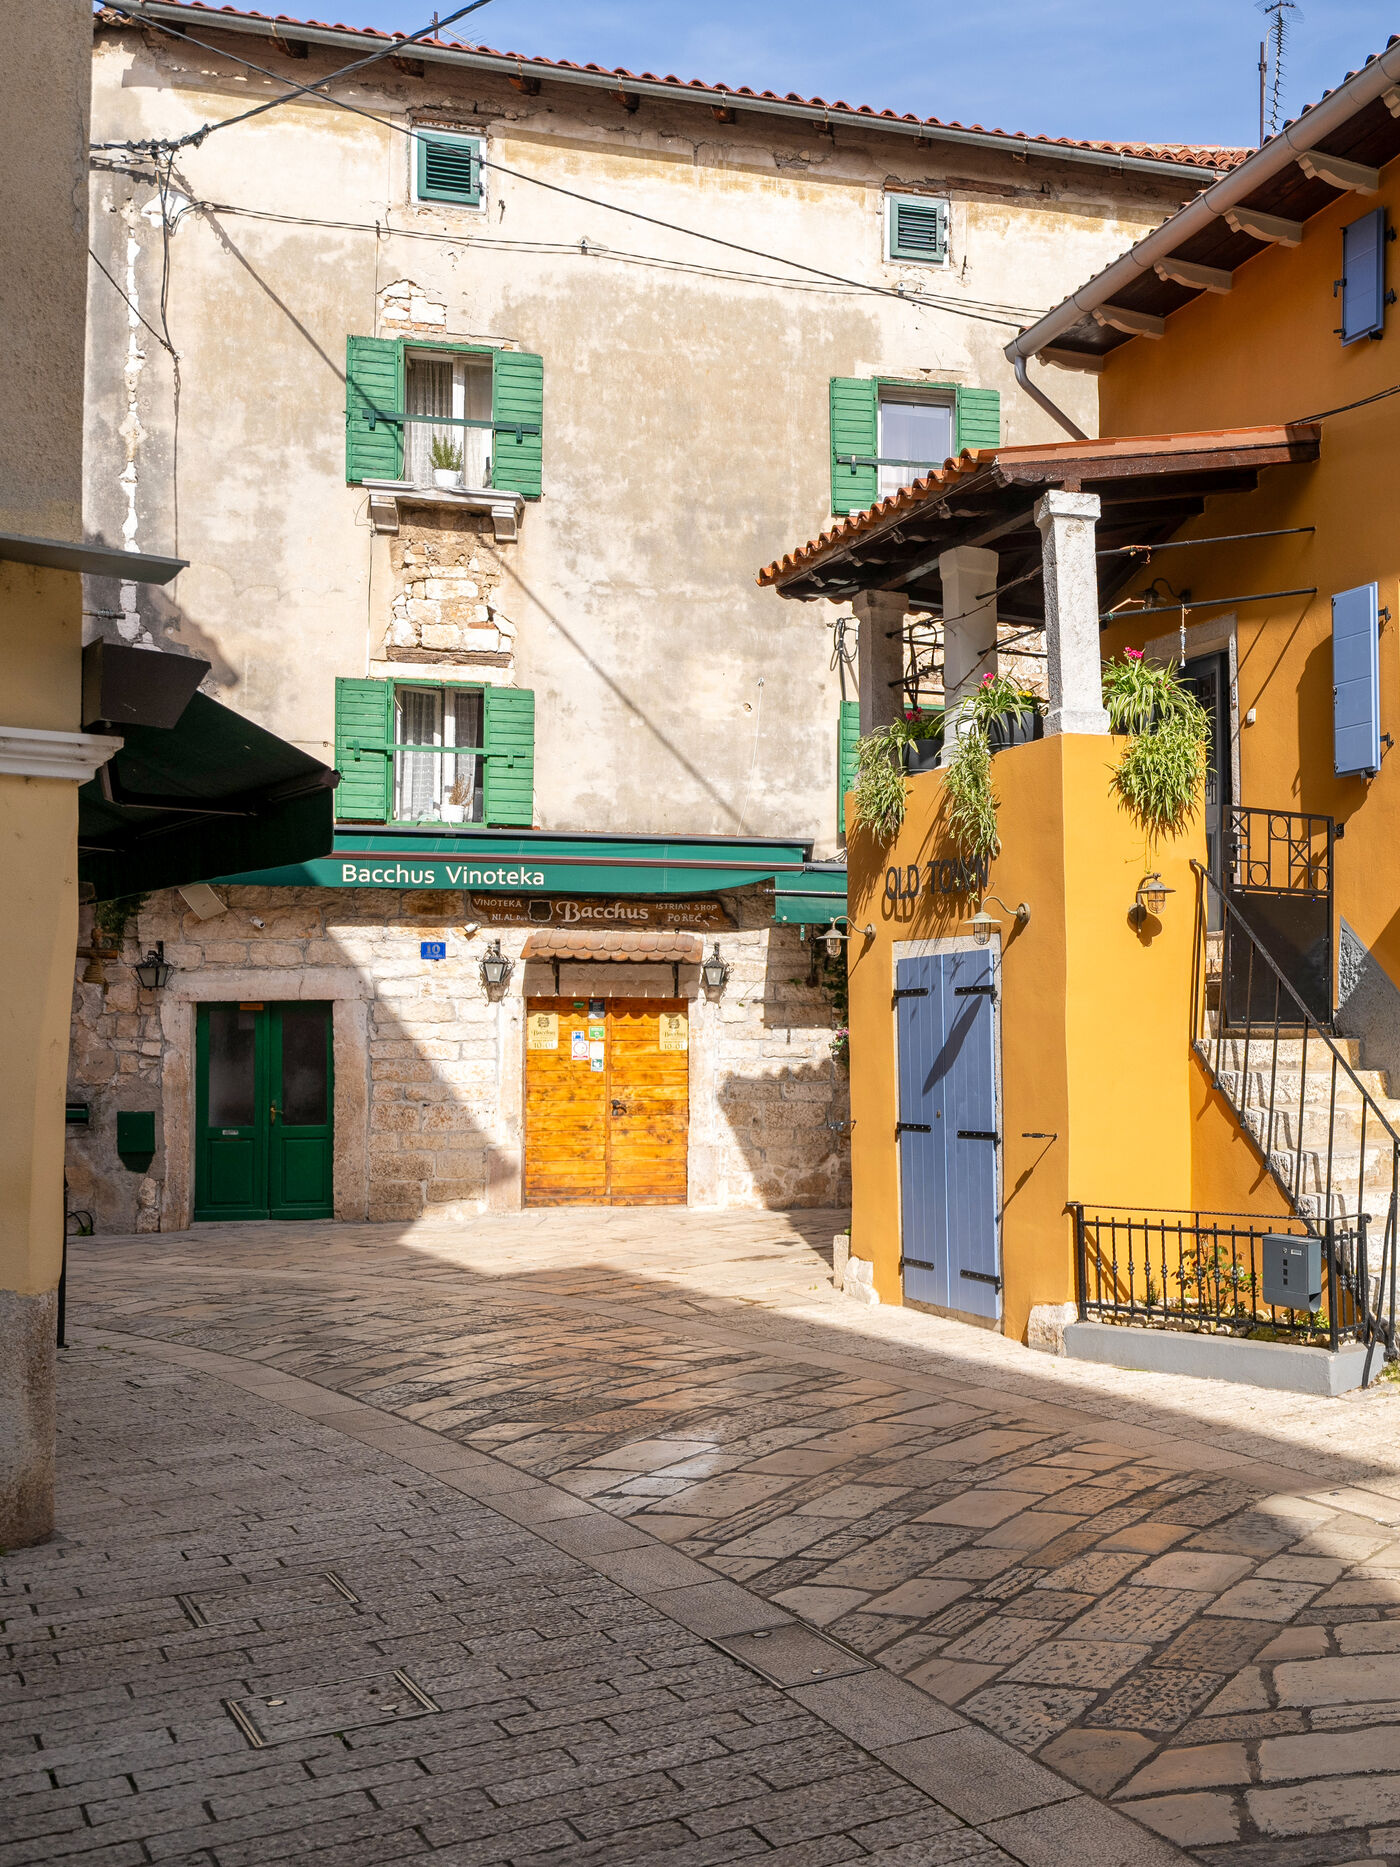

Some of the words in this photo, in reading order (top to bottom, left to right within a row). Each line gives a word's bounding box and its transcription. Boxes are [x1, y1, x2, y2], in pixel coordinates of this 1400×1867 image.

[341, 863, 436, 885] Bacchus
[445, 865, 545, 886] Vinoteka
[885, 864, 920, 901] OLD
[926, 850, 989, 895] TOWN
[473, 898, 522, 908] VINOTEKA
[555, 900, 649, 923] Bacchus
[655, 902, 691, 911] ISTRIAN
[426, 944, 441, 955] 10
